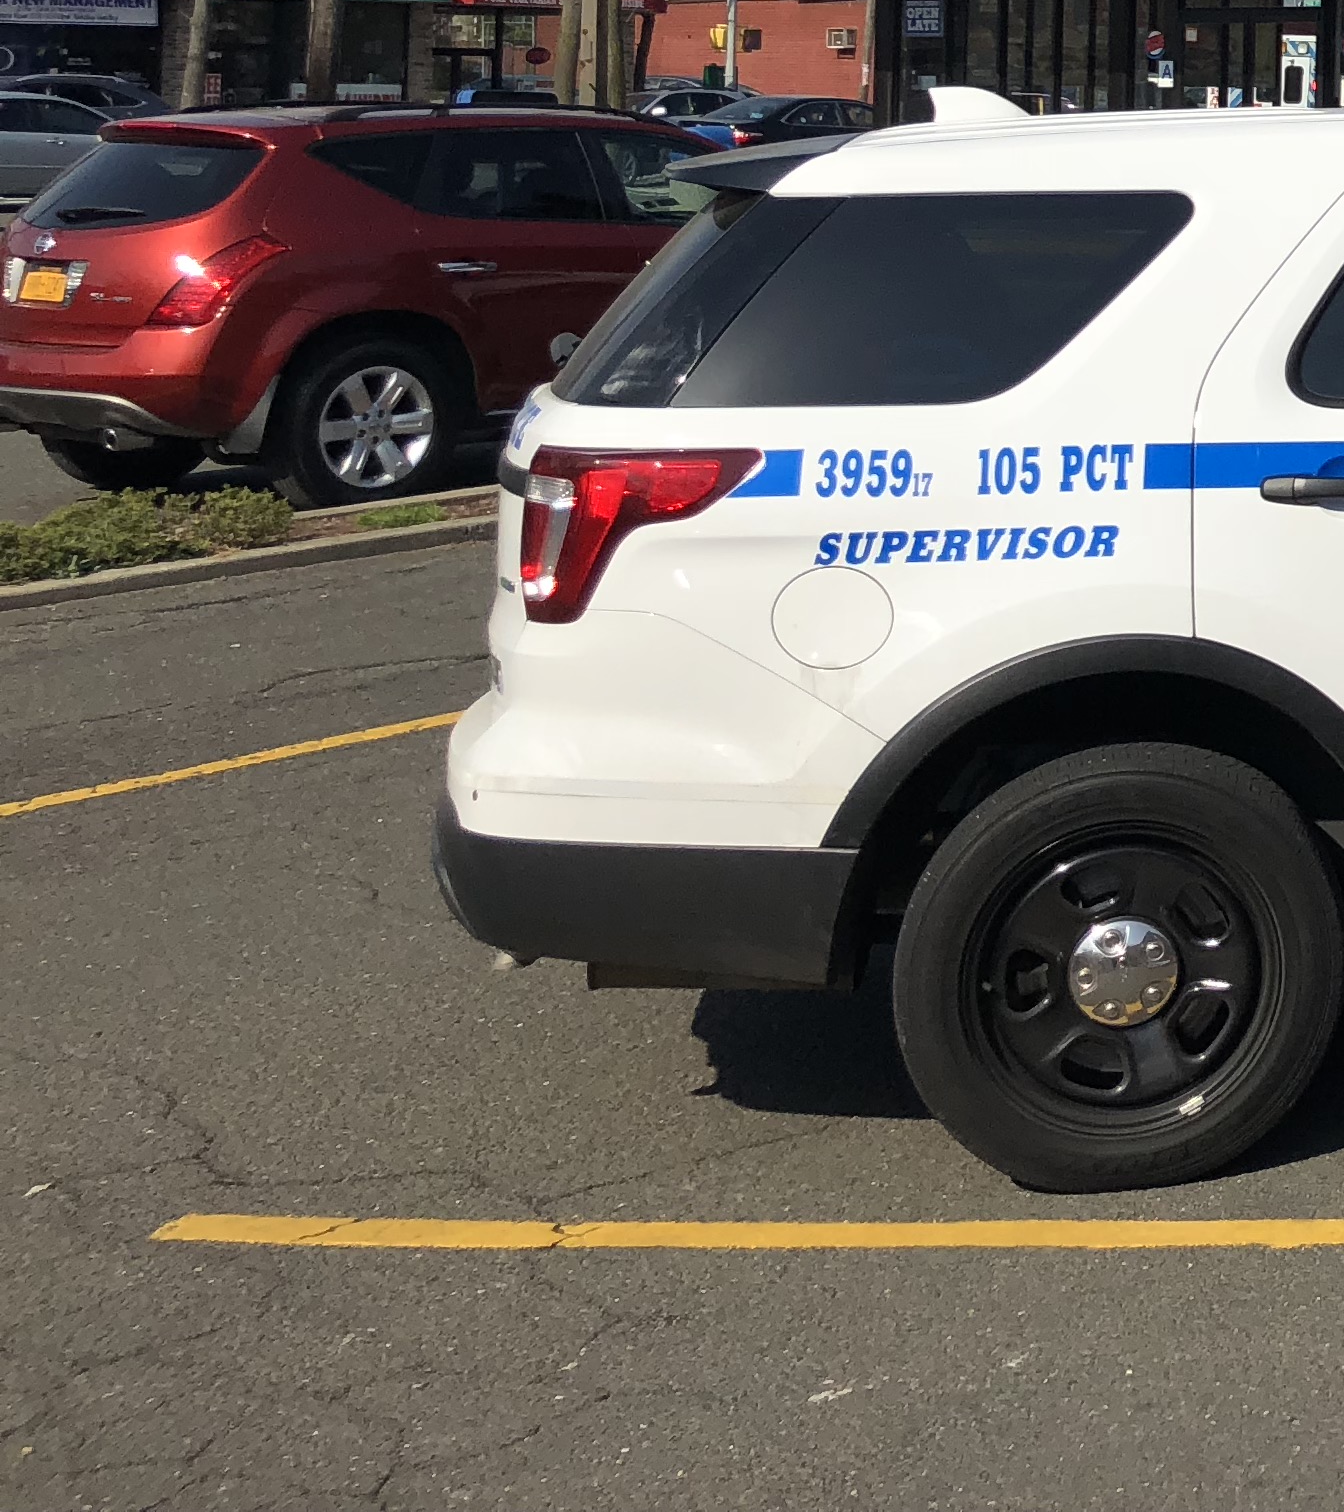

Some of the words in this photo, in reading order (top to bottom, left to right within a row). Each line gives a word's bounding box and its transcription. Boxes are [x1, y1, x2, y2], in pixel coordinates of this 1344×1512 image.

[906, 7, 939, 19] OPEN
[907, 19, 939, 31] LATE
[1161, 64, 1172, 79] A
[977, 445, 1041, 495] 105
[1059, 443, 1134, 491] PCT
[814, 525, 1120, 567] SUPERVISOR
